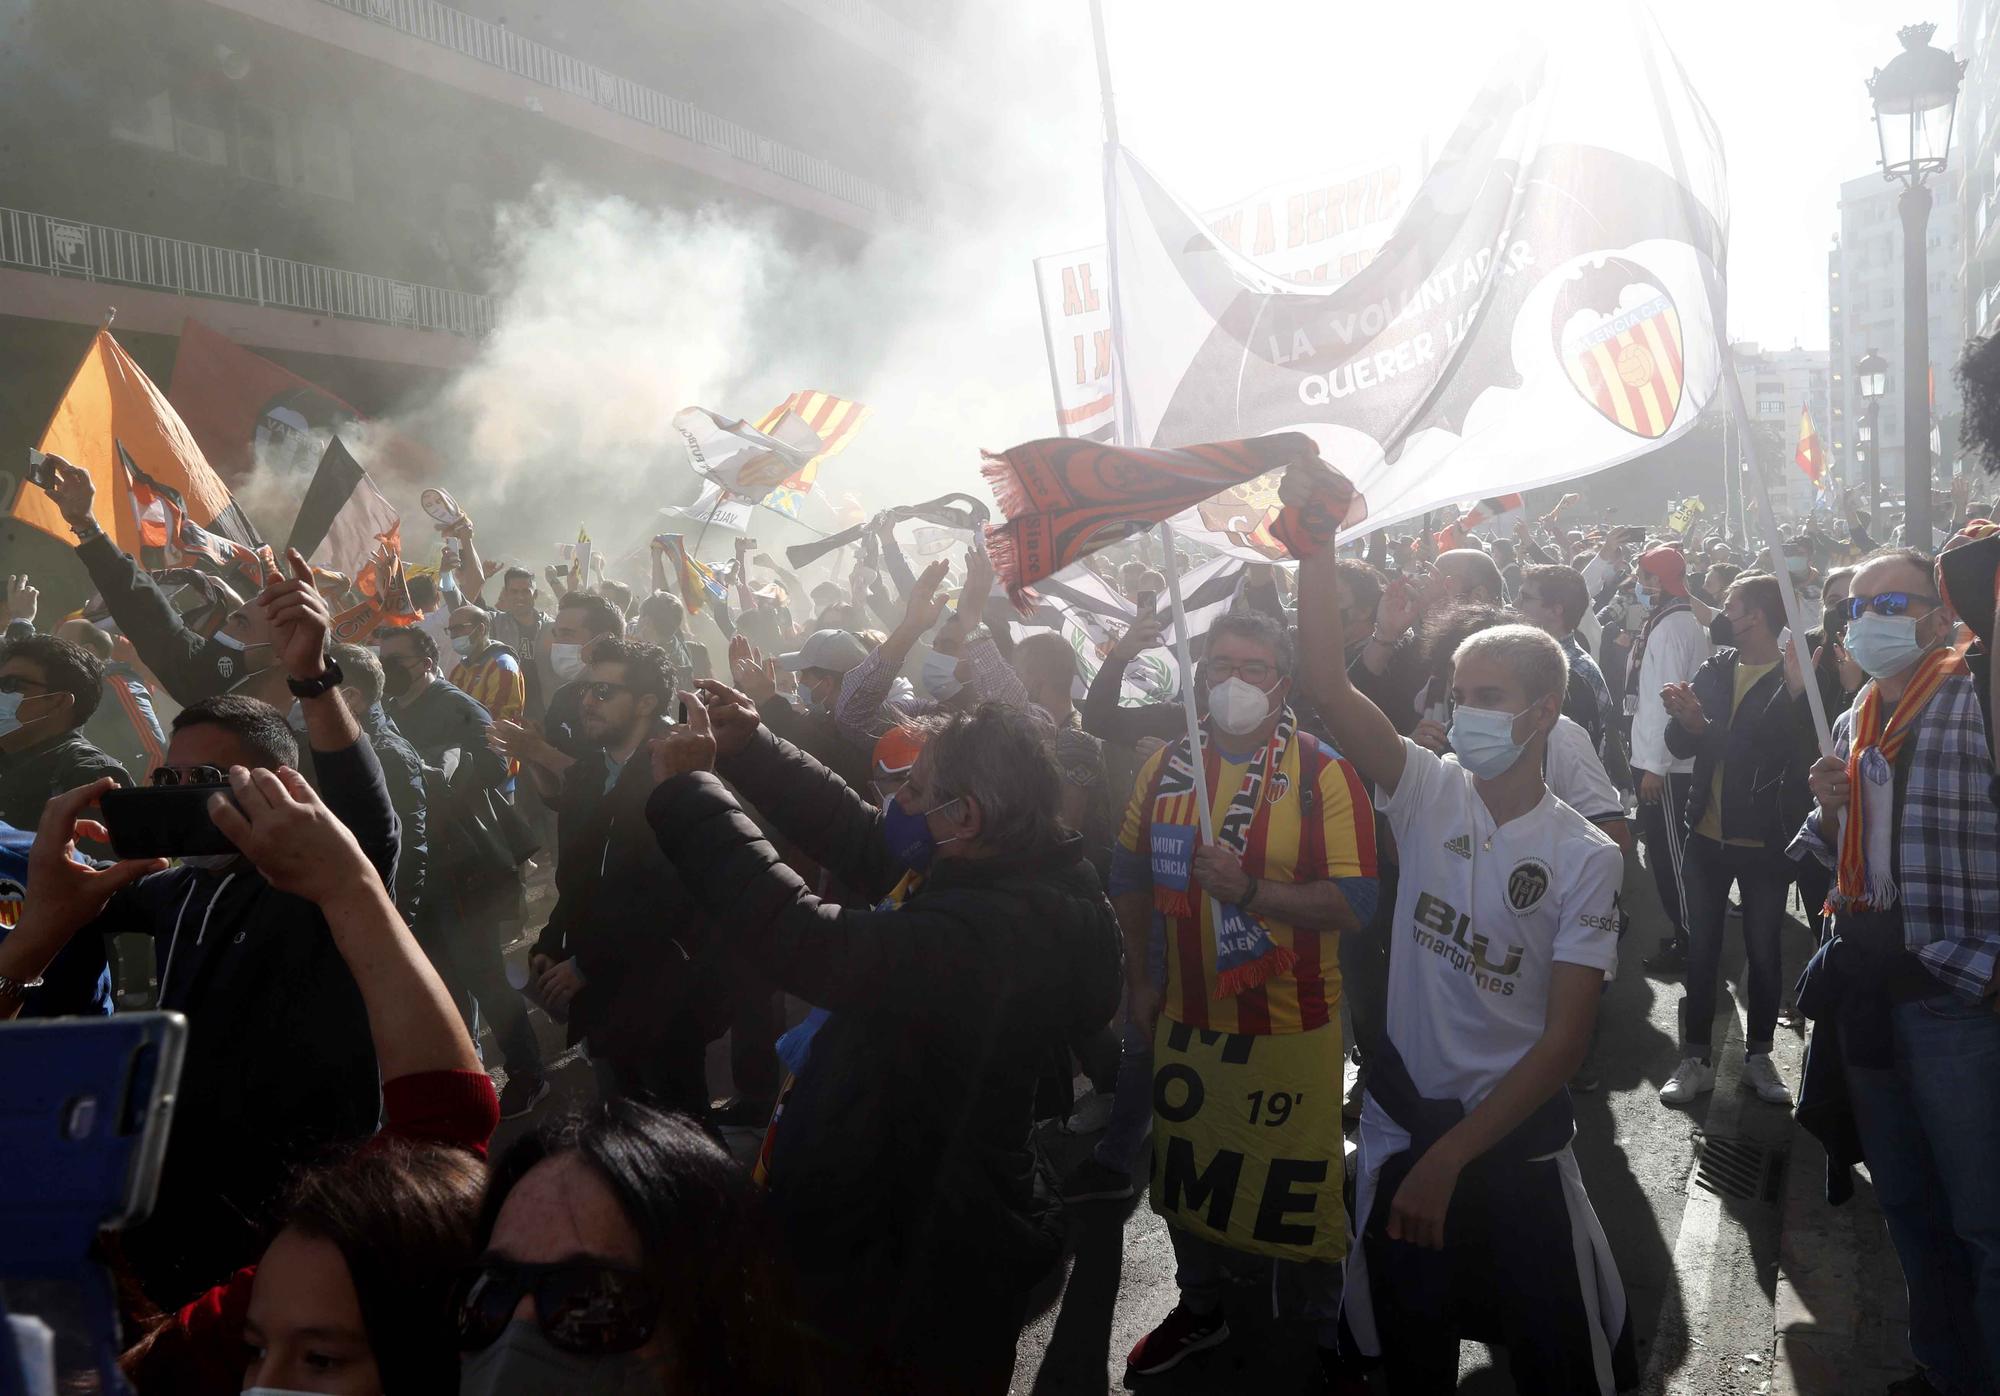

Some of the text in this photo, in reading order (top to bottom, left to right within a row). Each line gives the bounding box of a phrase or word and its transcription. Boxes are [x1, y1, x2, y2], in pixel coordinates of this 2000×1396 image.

[1268, 328, 1316, 364] LA
[1330, 246, 1491, 345] VOLUNTAD
[1298, 332, 1435, 406] QUERER
[1444, 841, 1472, 860] adidas
[1413, 891, 1525, 976] BLU
[1579, 911, 1621, 933] sesde
[1247, 1089, 1303, 1128] 19'
